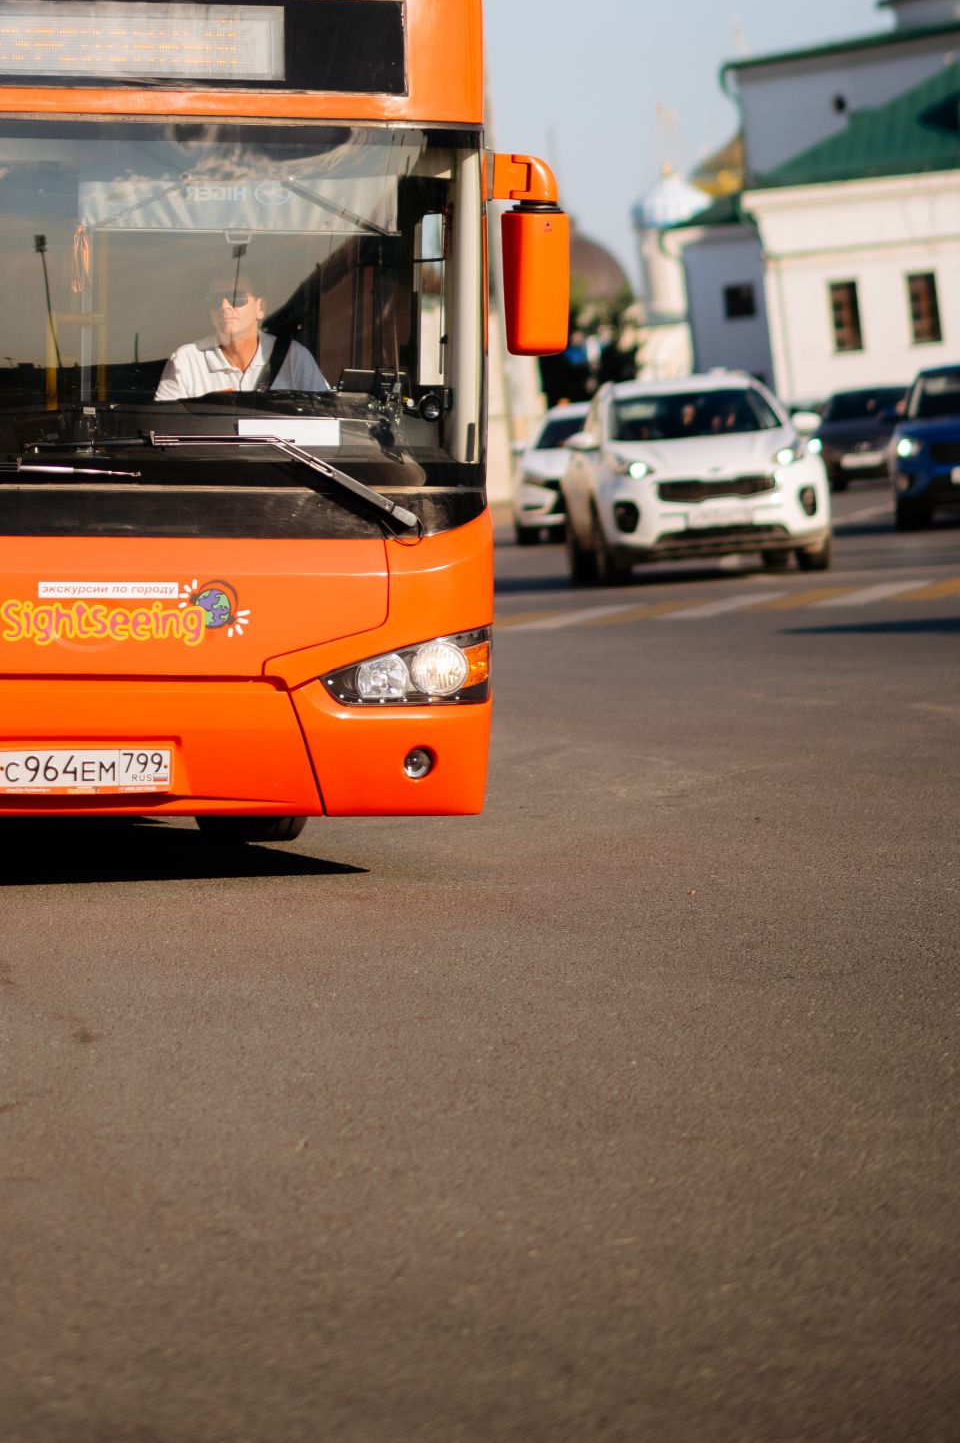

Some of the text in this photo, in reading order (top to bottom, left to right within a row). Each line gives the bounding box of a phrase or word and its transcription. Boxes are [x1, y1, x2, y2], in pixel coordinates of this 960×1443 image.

[41, 584, 175, 595] экскурсии по городу
[1, 600, 206, 646] Sightseeing
[122, 752, 164, 773] 799
[131, 774, 152, 782] RUS
